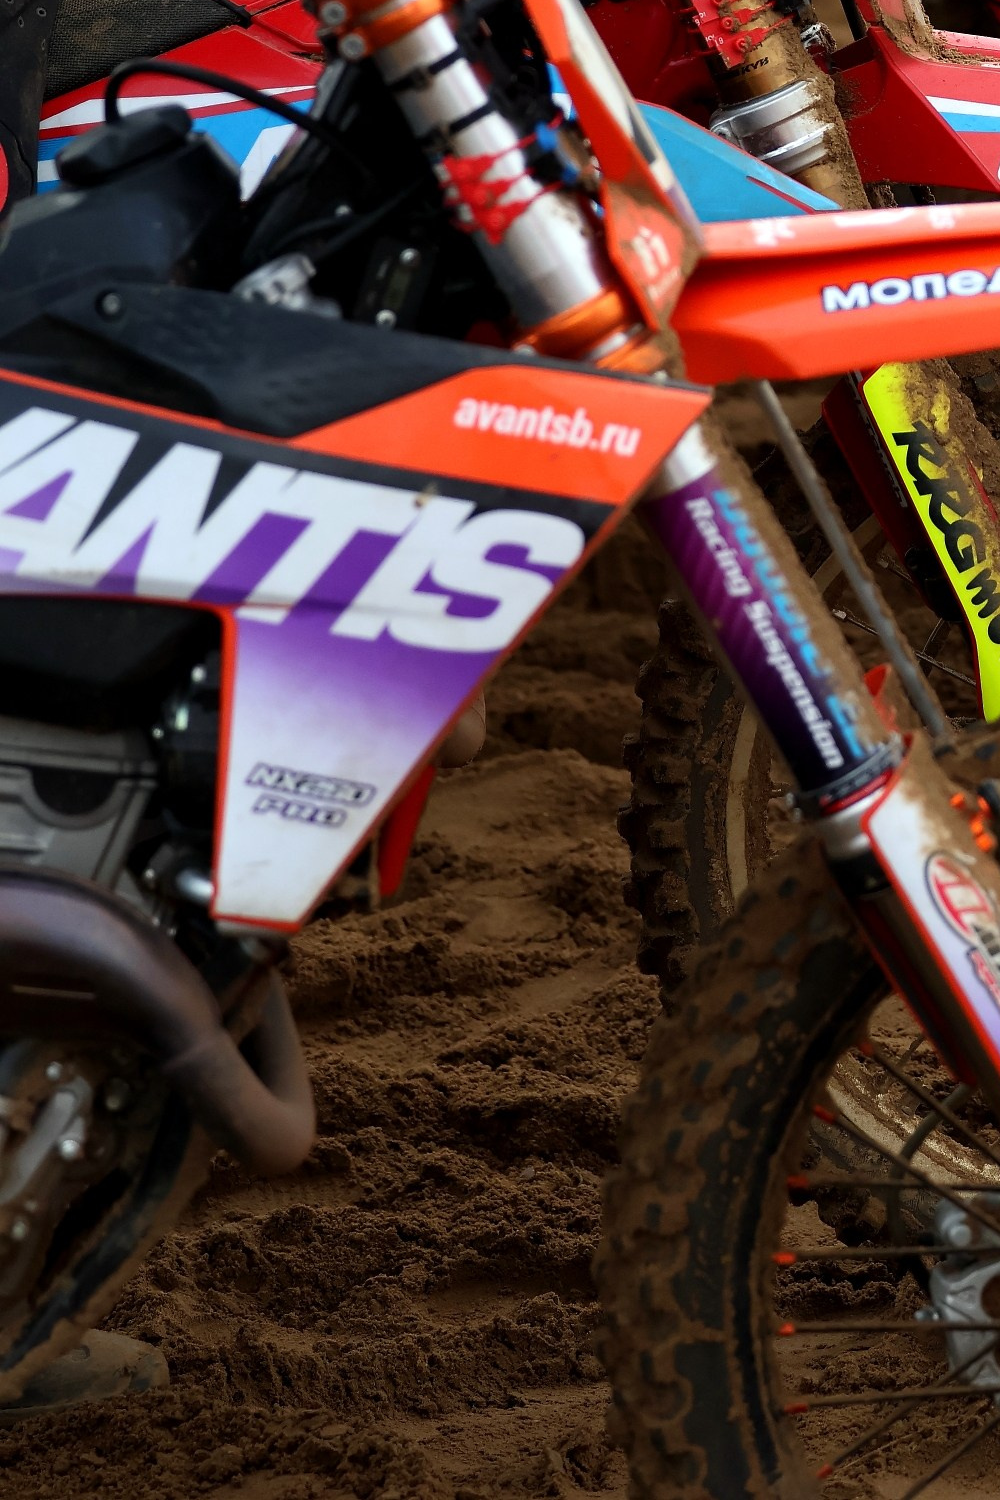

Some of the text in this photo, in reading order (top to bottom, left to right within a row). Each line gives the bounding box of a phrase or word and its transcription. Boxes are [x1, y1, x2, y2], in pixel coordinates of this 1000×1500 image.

[453, 395, 641, 457] avantsb.ru
[685, 497, 753, 598] Racing
[743, 599, 845, 769] Suspension
